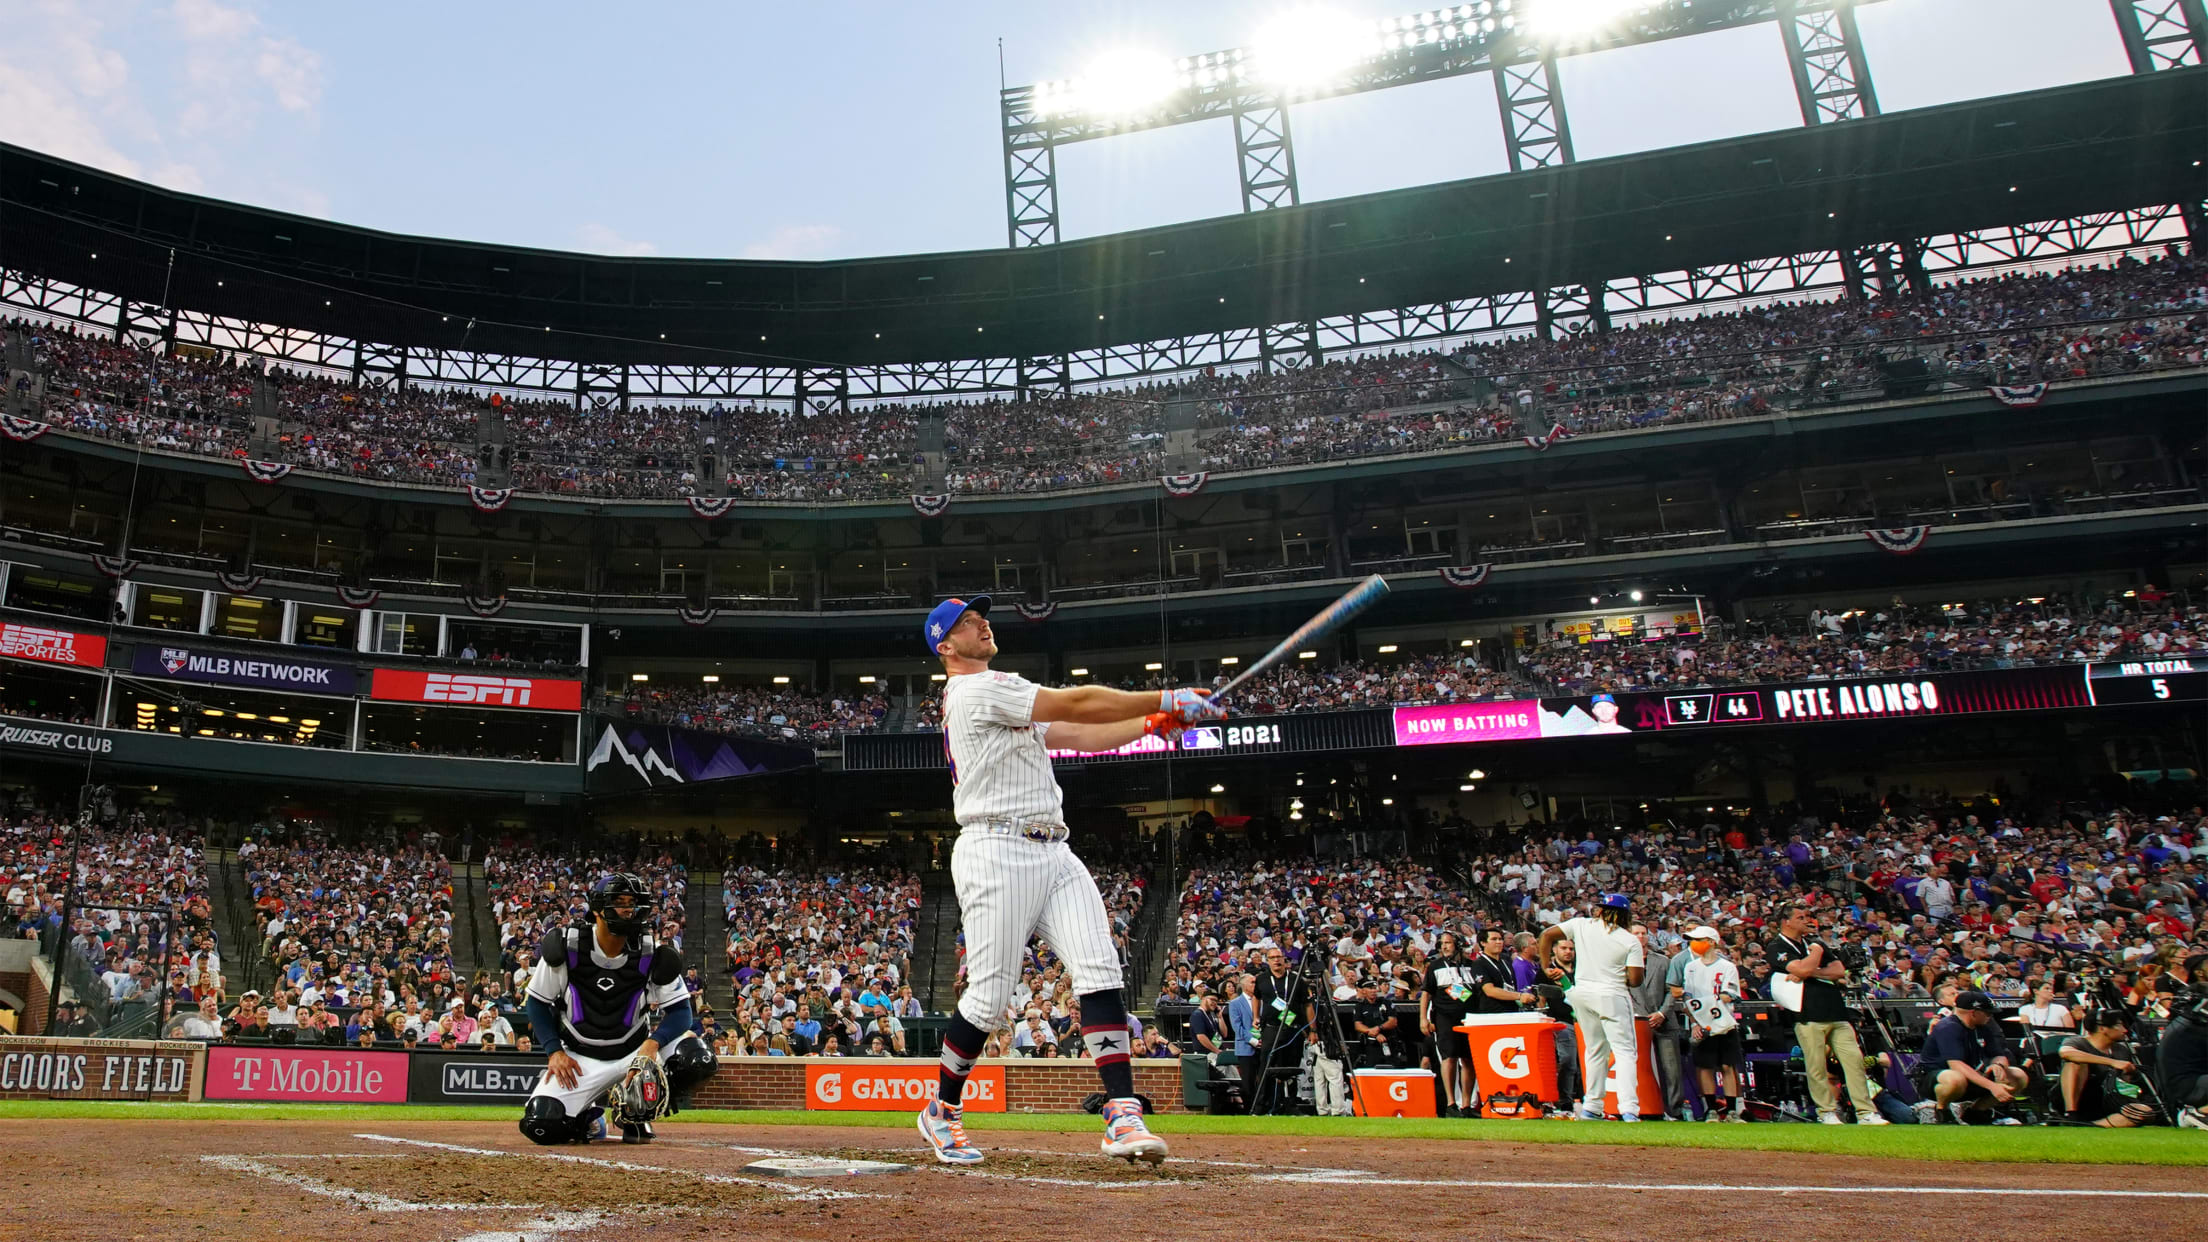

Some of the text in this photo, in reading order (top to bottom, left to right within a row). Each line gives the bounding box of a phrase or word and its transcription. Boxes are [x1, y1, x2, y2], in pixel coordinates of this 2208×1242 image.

[2, 624, 75, 650] ESPN
[163, 649, 186, 660] MLB
[188, 655, 329, 685] MLB NETWORK
[2120, 659, 2194, 676] HR TOTAL
[423, 673, 532, 705] ESPN
[1774, 681, 1939, 719] PETE ALONSO
[2151, 679, 2169, 699] 5
[1727, 698, 1748, 717] 44
[1407, 712, 1529, 734] NOW BATTING
[63, 734, 112, 753] CLUB
[1227, 725, 1281, 746] 2021
[83, 1040, 130, 1048] @ROCKIES
[1488, 1036, 1530, 1079] G
[1, 1053, 185, 1092] COORS FIELD
[267, 1058, 383, 1094] Mobile
[852, 1078, 995, 1101] GATORDE
[1389, 1081, 1408, 1101] G
